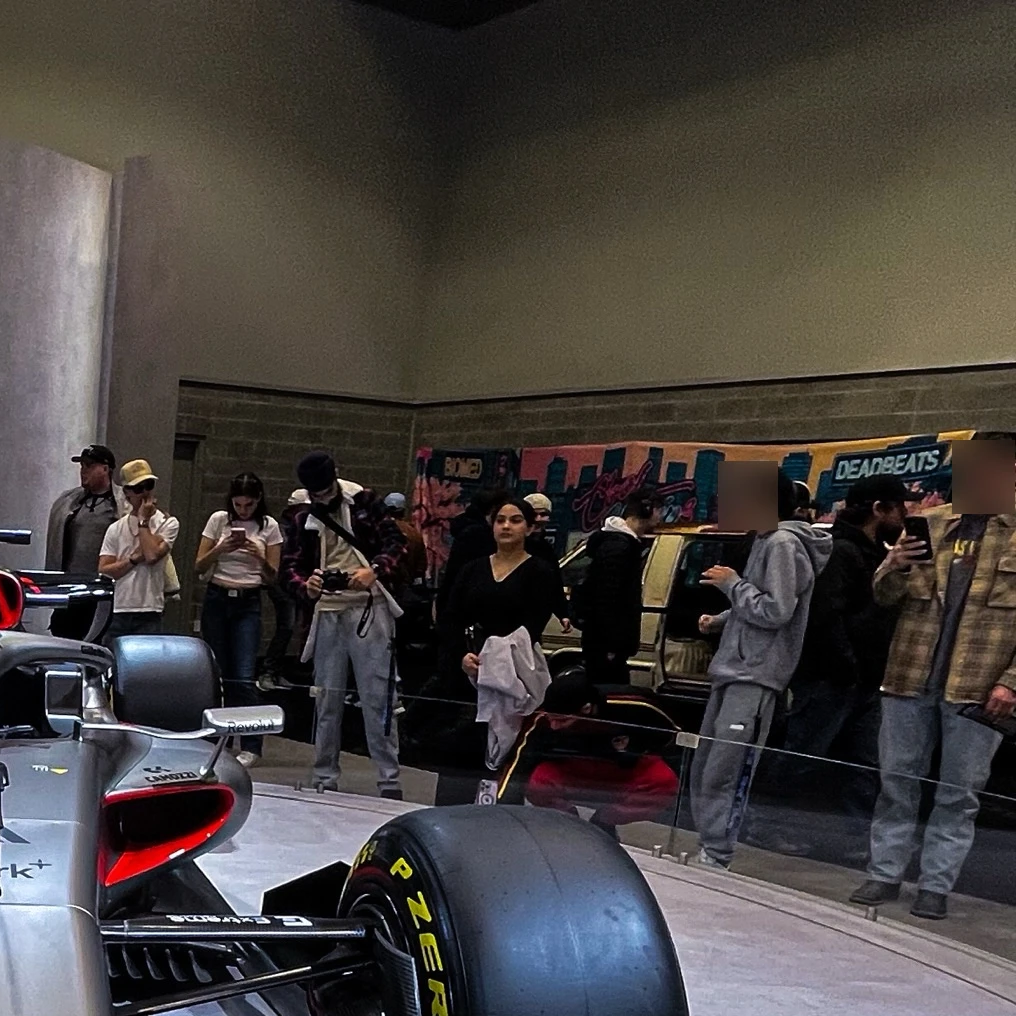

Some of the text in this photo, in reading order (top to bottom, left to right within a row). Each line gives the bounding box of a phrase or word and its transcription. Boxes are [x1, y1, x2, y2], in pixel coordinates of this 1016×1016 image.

[835, 450, 940, 480] DEADBEATS
[227, 719, 275, 733] Revolut
[145, 771, 198, 783] CAMOZZI
[390, 857, 413, 880] P
